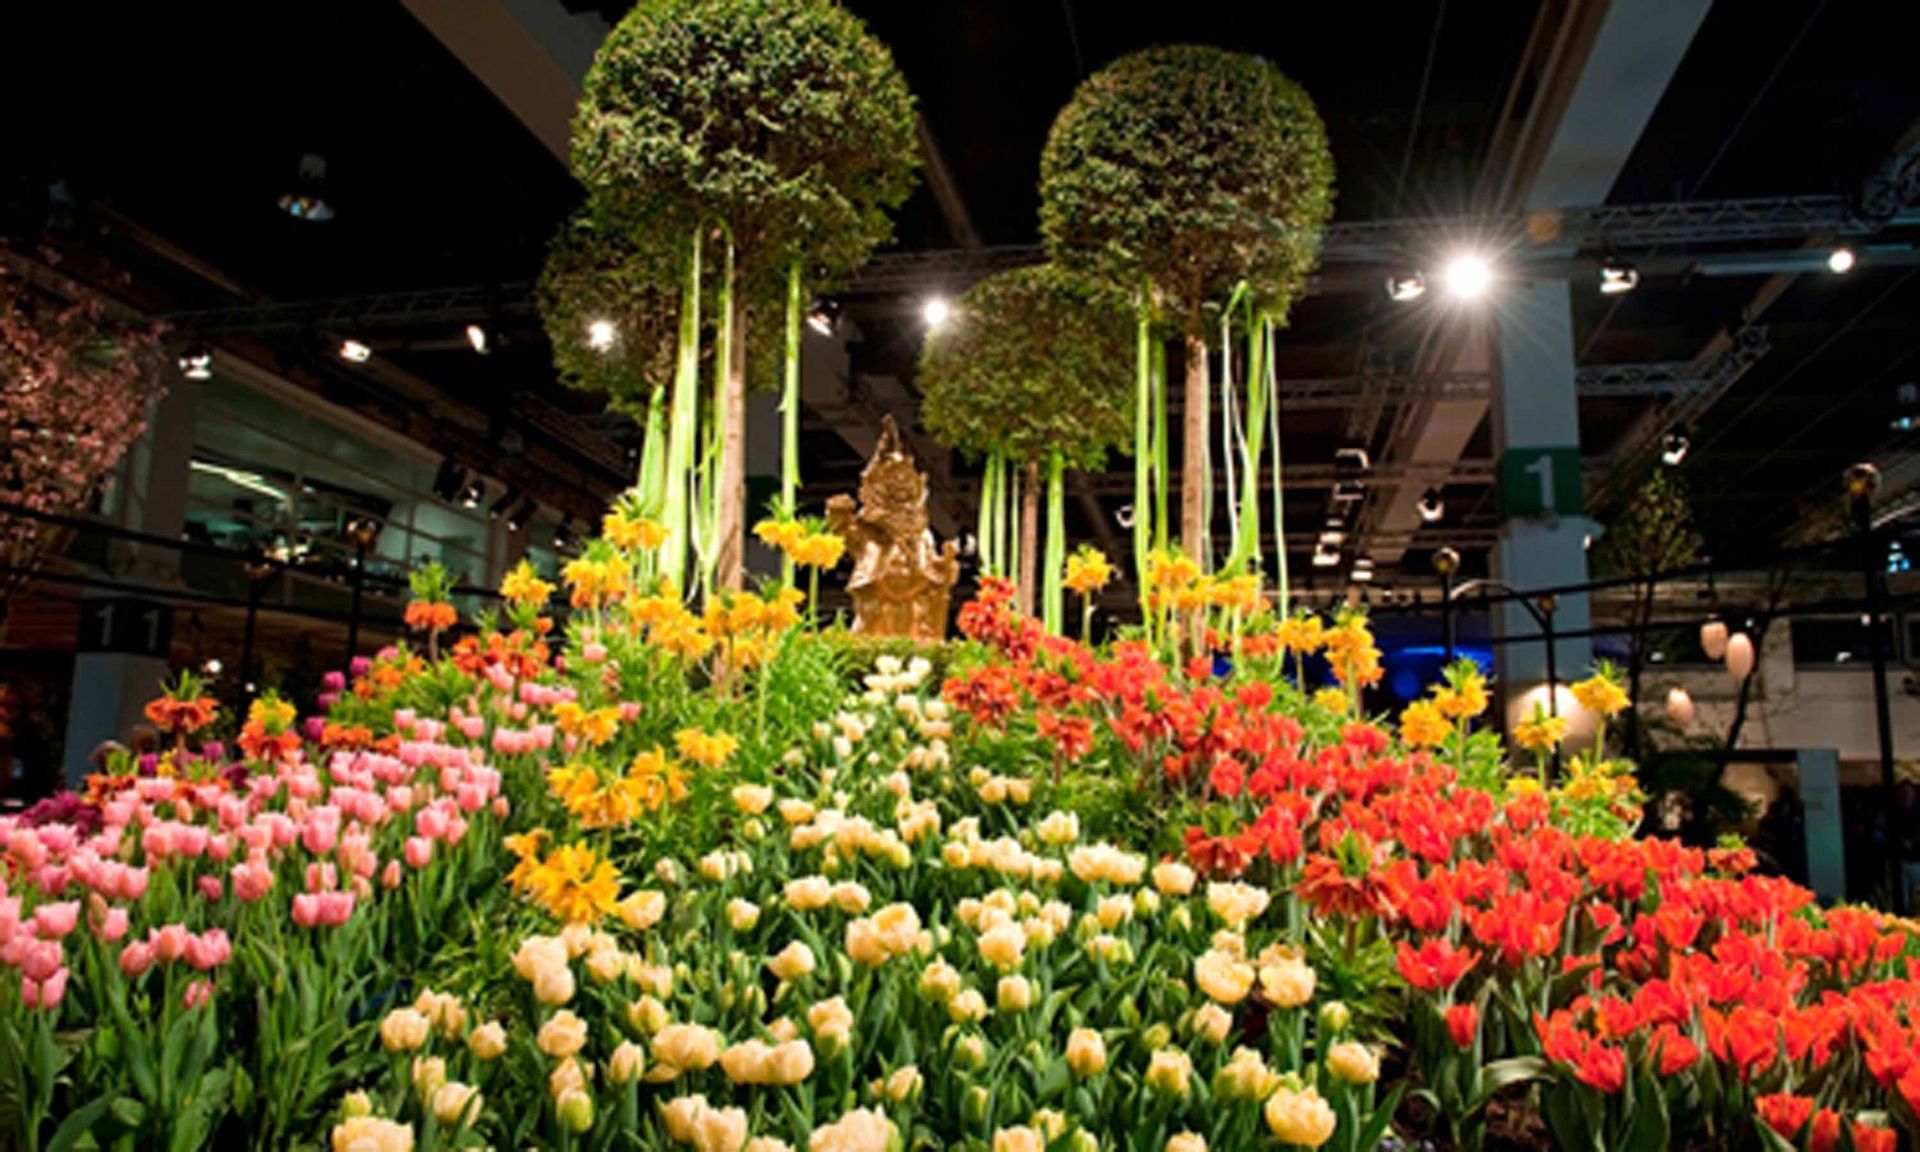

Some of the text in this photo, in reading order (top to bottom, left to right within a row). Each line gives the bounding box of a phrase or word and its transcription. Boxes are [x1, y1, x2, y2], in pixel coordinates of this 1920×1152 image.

[1524, 454, 1554, 509] 1
[96, 603, 114, 647] 1
[141, 608, 159, 651] 1
